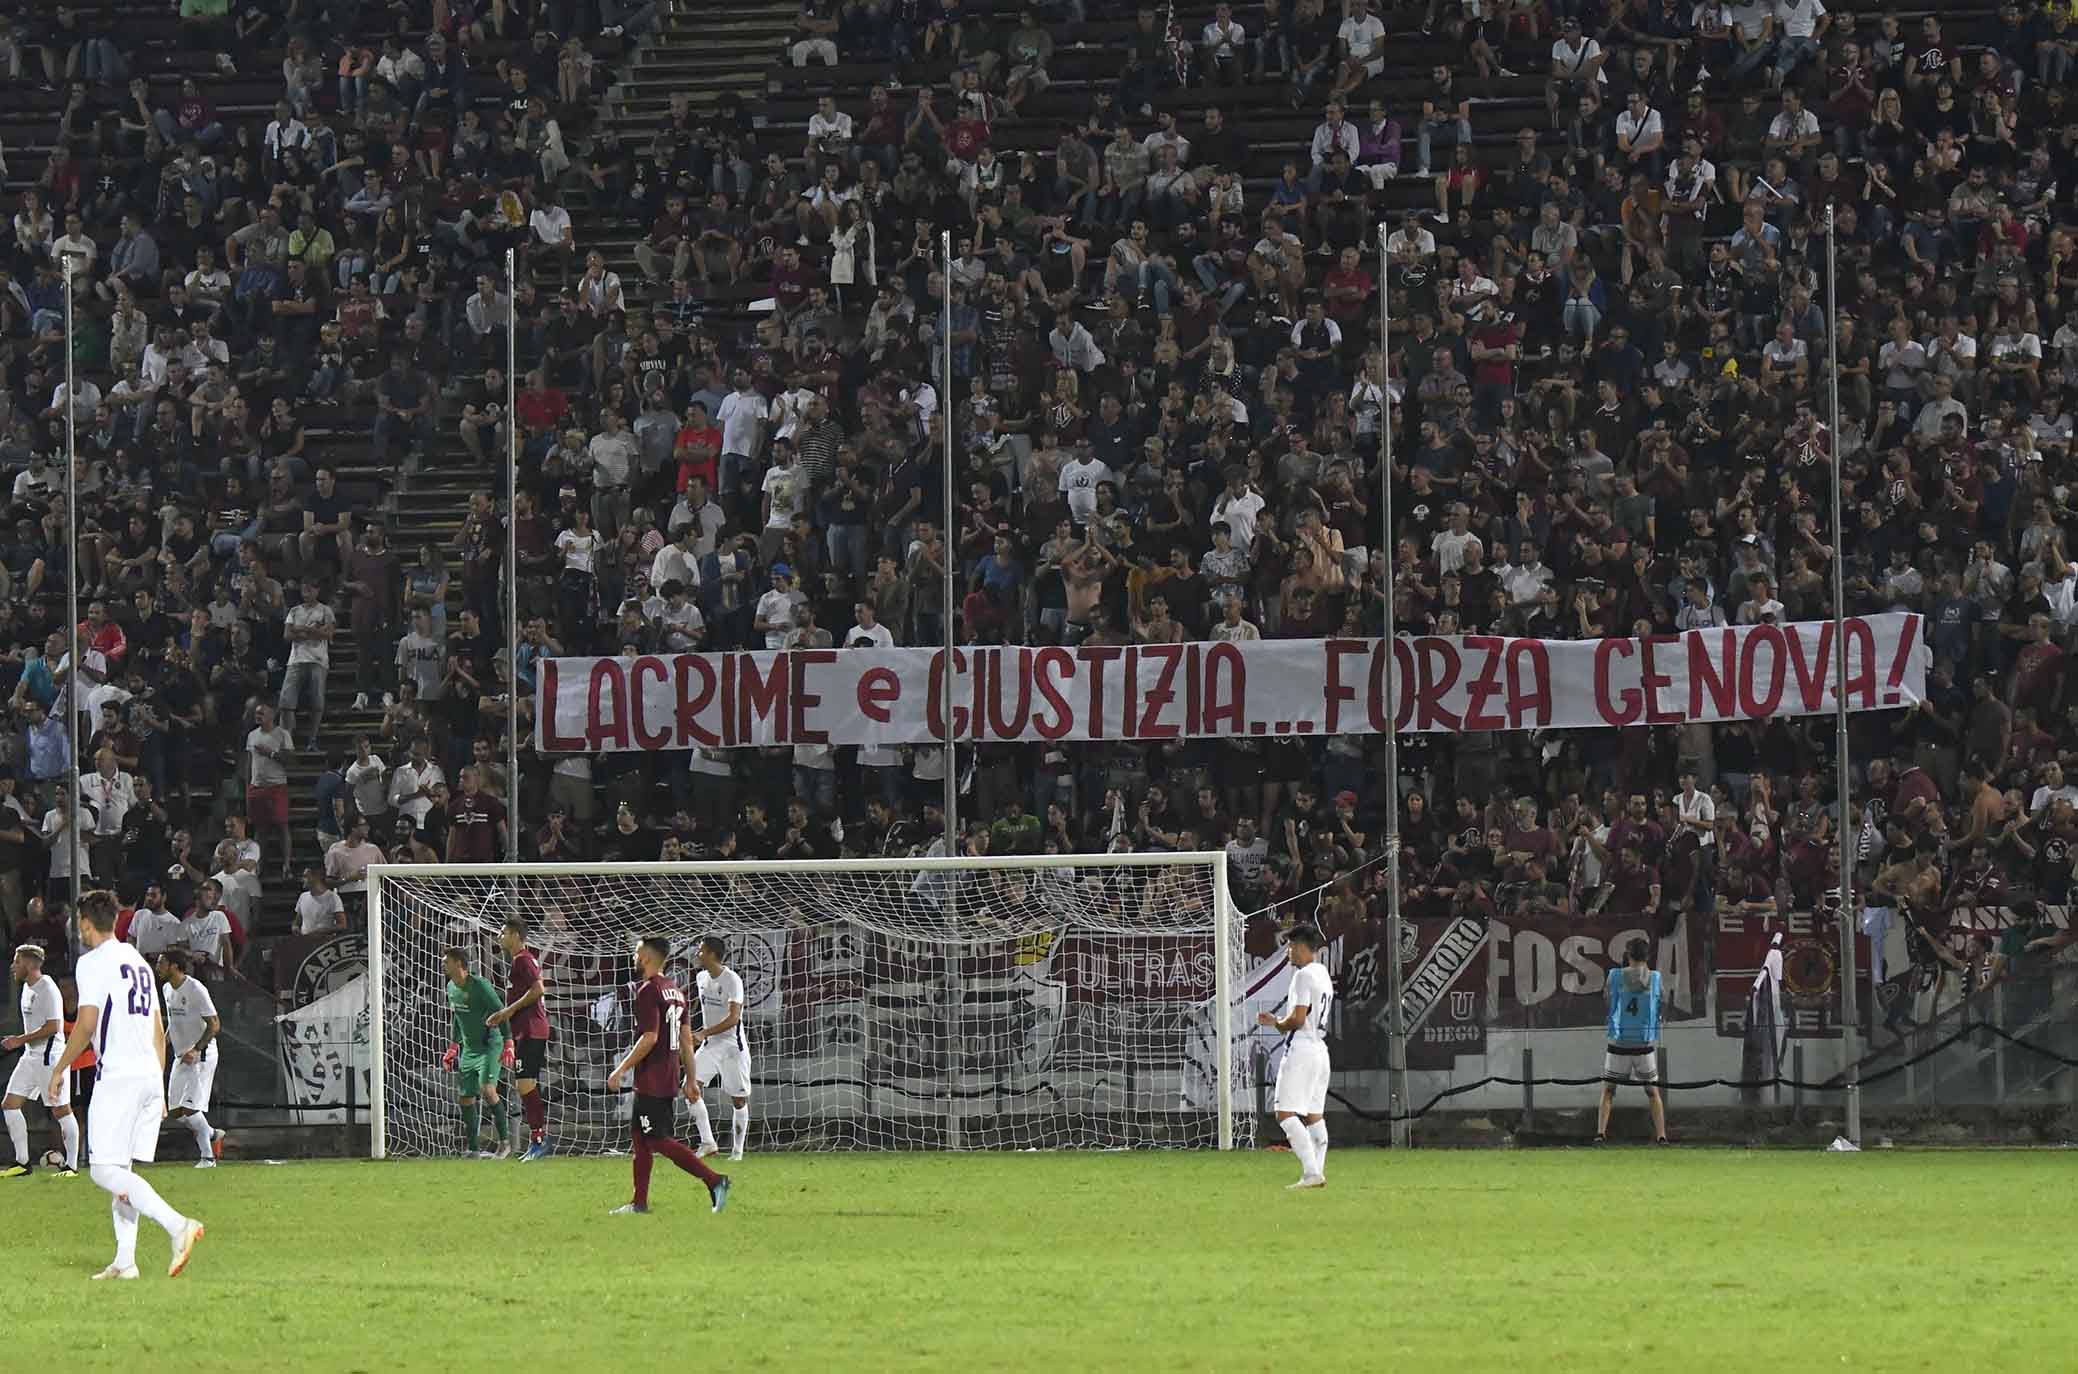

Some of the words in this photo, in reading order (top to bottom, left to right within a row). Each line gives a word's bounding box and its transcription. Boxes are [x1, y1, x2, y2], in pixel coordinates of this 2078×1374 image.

[543, 651, 837, 751] LACRIME
[857, 667, 900, 723] e
[1323, 636, 1553, 734] FORZA
[1593, 613, 1919, 727] GENOVA!
[1078, 951, 1216, 989] ULTRAS
[120, 963, 151, 1016] 28
[1626, 997, 1640, 1017] 4
[1075, 1001, 1192, 1037] AREZZ
[1424, 1023, 1480, 1042] DIEGO
